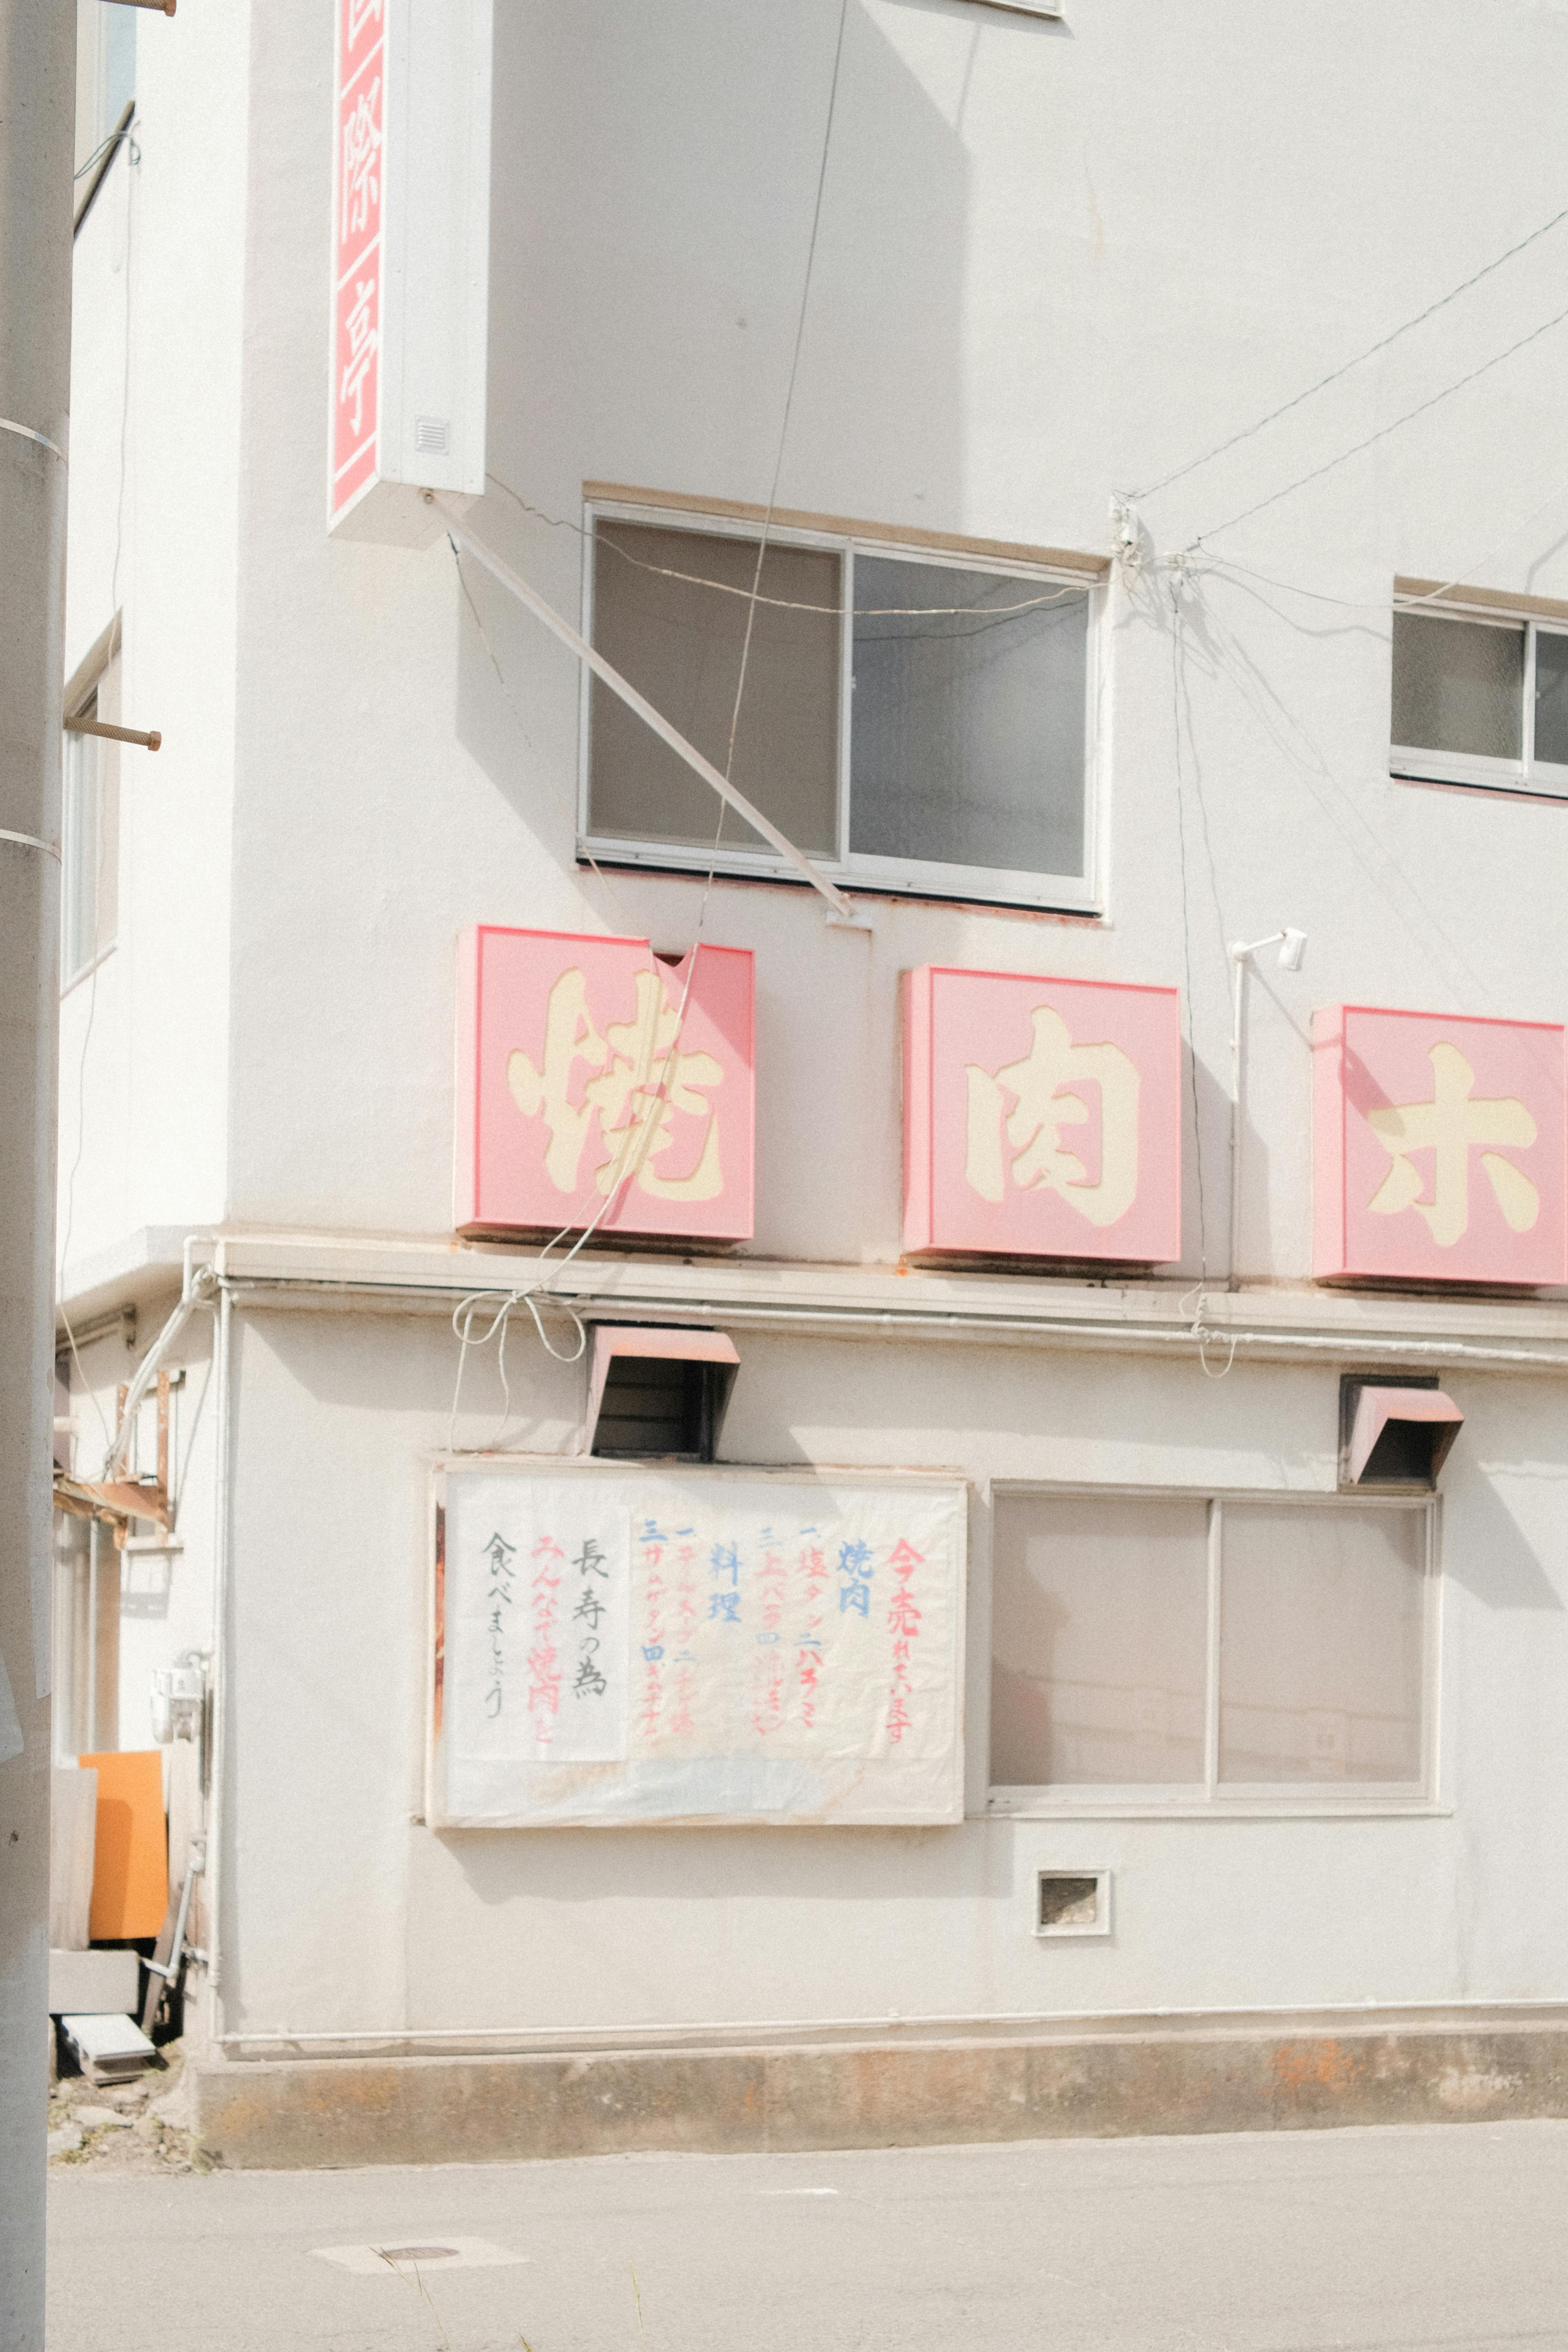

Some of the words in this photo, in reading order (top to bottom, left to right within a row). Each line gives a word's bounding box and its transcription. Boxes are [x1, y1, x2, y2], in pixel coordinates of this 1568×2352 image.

[526, 1535, 565, 1744] みんなで焼肉を
[571, 1538, 609, 1700] 長寿の為
[707, 1541, 743, 1623] 料理
[836, 1538, 875, 1618] 焼肉
[885, 1537, 927, 1745] 今売れています
